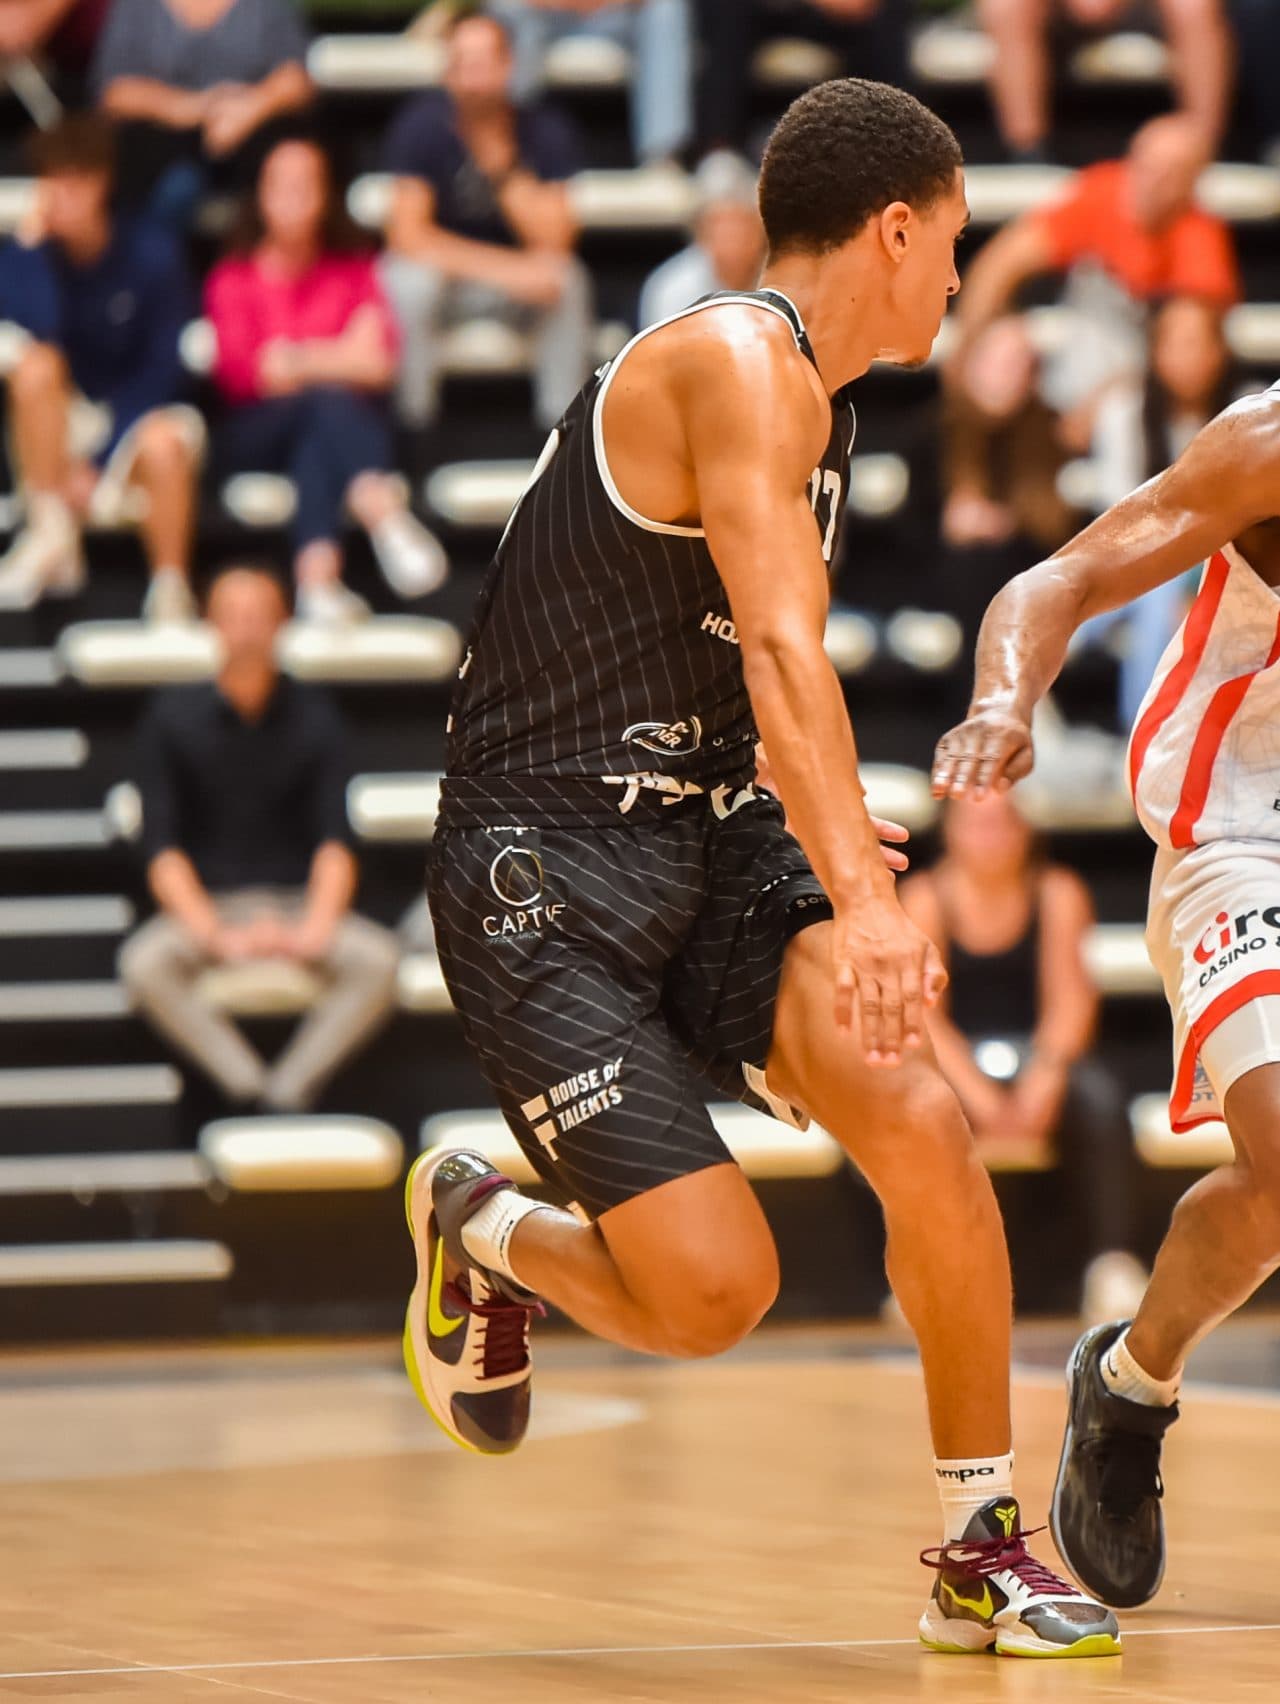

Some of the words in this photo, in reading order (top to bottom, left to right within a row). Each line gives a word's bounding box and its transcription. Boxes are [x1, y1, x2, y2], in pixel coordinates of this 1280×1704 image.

[482, 904, 566, 937] CAPTIF
[1199, 937, 1266, 987] CASINO
[549, 1068, 601, 1107] HOUSE
[557, 1084, 622, 1132] TALENTS
